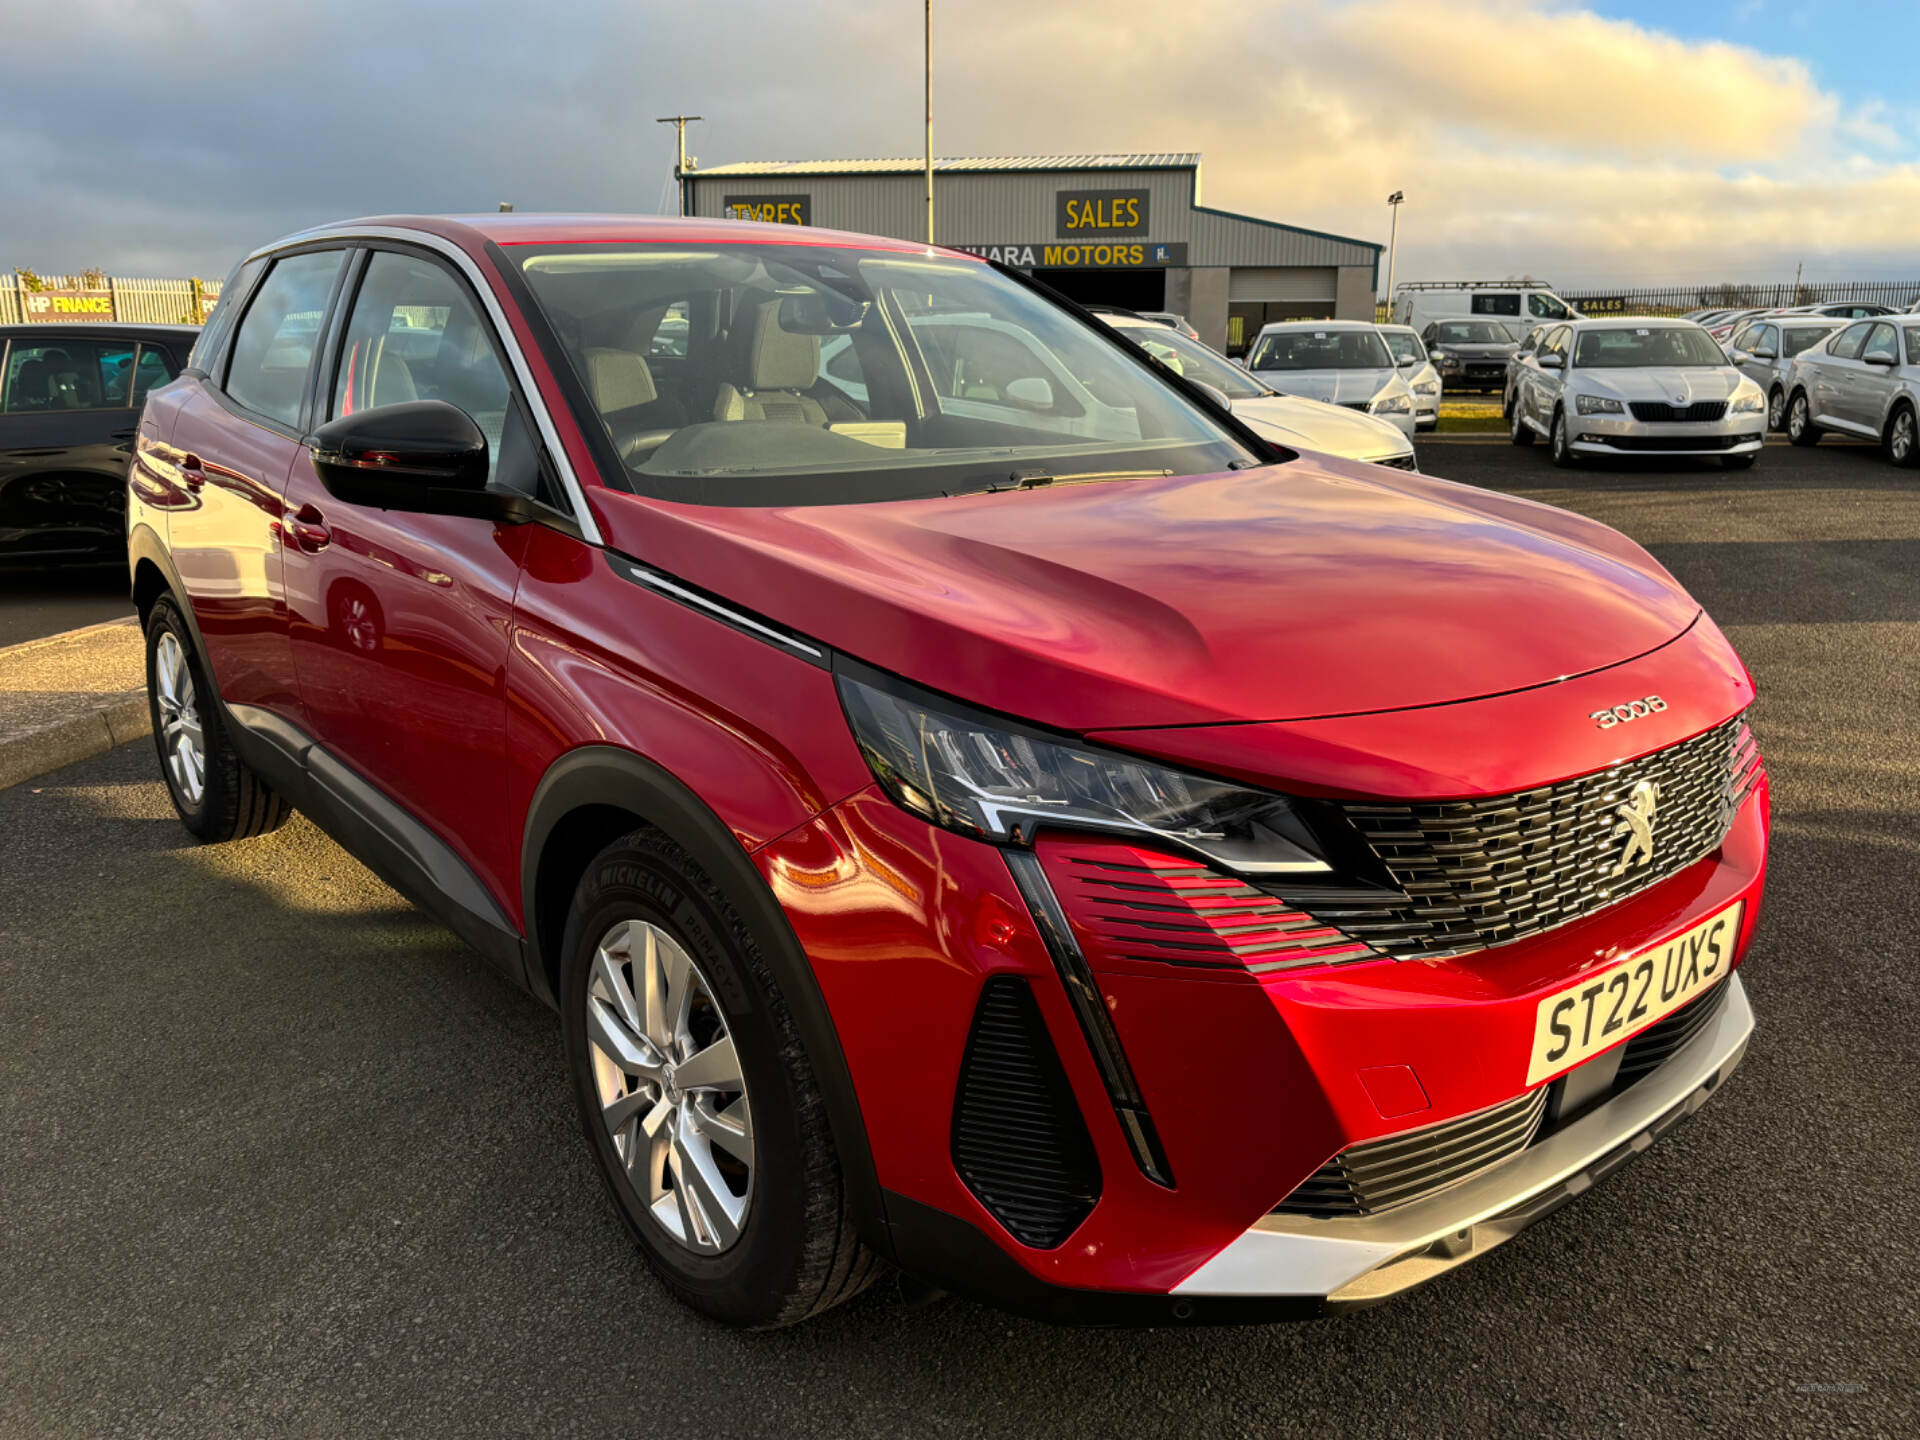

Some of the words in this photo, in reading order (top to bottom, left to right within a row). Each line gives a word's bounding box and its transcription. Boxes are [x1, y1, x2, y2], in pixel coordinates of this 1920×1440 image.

[732, 203, 803, 226] TYRES
[1066, 198, 1140, 229] SALES
[1043, 245, 1144, 266] MOTORS
[29, 297, 51, 312] HP
[53, 297, 112, 312] FINANCE
[1583, 300, 1622, 311] SALES
[1589, 695, 1667, 729] 3008
[601, 866, 677, 907] MICHELIN
[686, 916, 734, 987] PRIMACY
[1546, 959, 1654, 1062] ST22
[1660, 919, 1725, 1002] UXS
